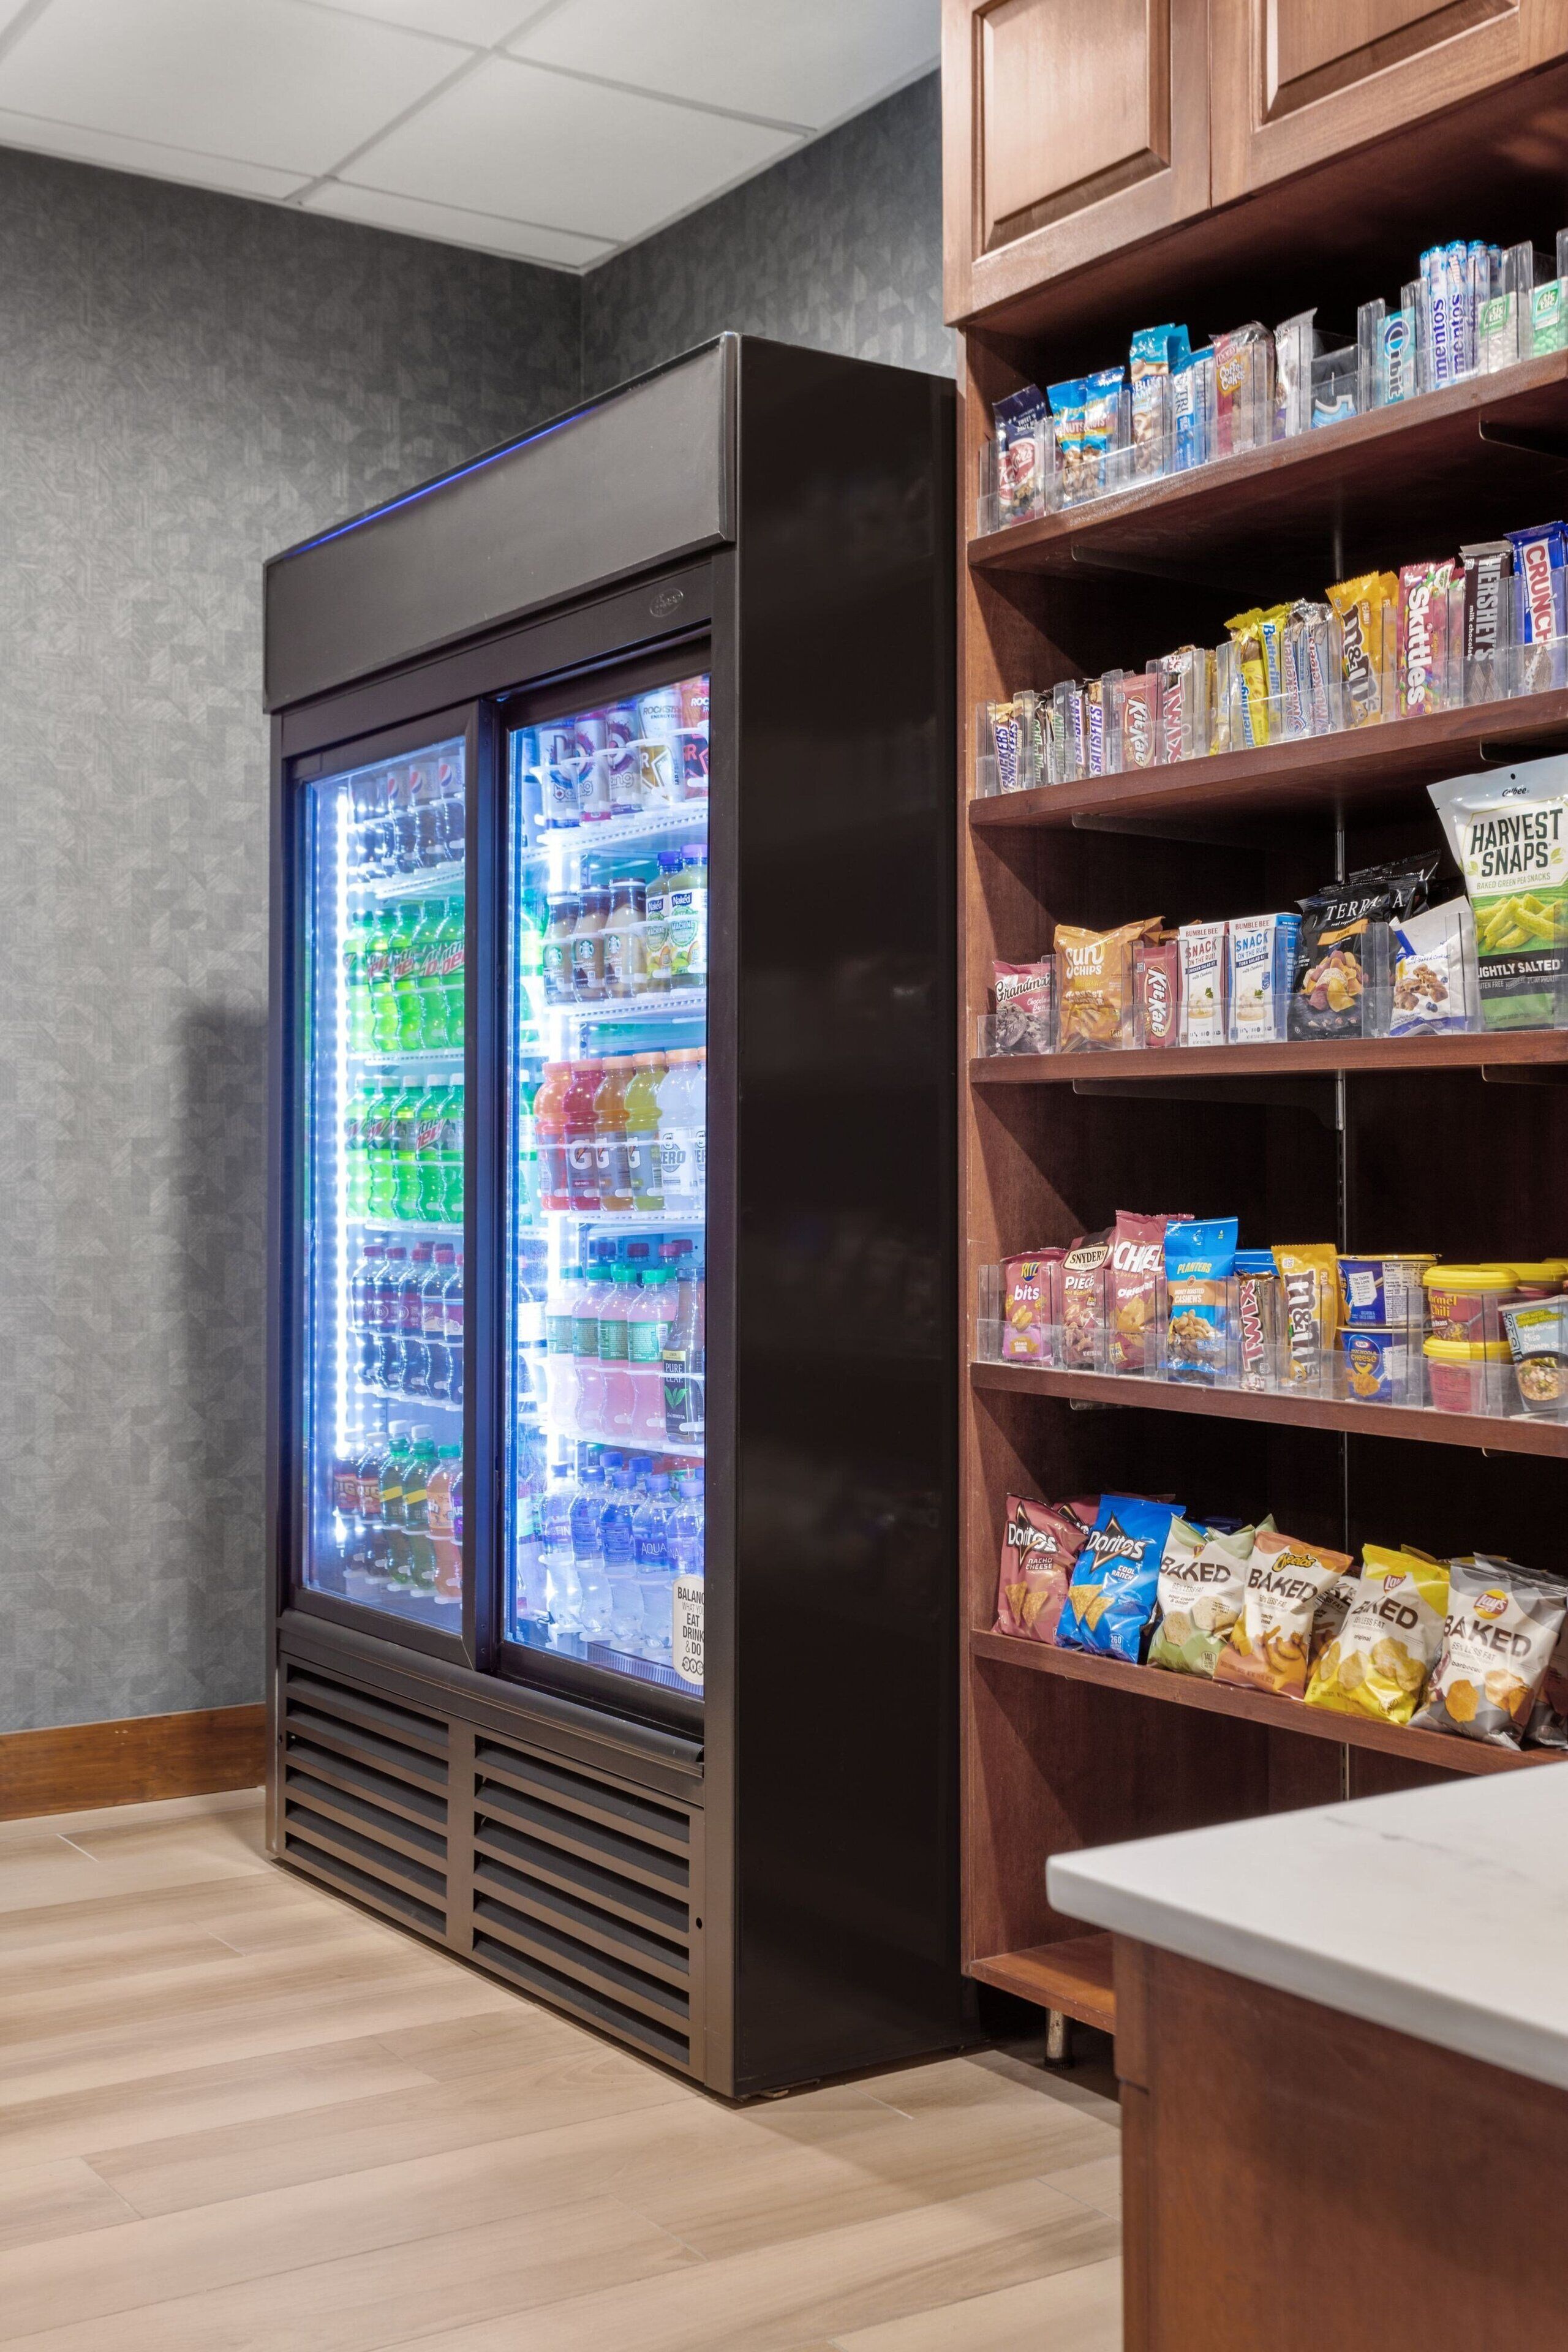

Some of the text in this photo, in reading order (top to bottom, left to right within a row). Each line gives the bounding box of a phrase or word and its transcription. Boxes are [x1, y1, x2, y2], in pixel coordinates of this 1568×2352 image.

[1433, 298, 1447, 380] mentos
[1452, 293, 1465, 374] mentos
[1385, 317, 1410, 399] Orbit
[1219, 359, 1243, 377] Coffee
[1526, 545, 1552, 647] CRUNCH
[1474, 558, 1501, 662] HERSHEY'S
[1408, 586, 1432, 705] Skittles
[1163, 675, 1185, 764] TWIX
[1090, 705, 1103, 773] SATISFIES
[996, 726, 1009, 789] SNICKERS
[1008, 722, 1019, 788] SNICKERS
[1470, 808, 1563, 856] HARVEST
[1482, 842, 1548, 877] SNAPS
[1477, 881, 1496, 890] BAKED
[1498, 879, 1516, 888] GREEN
[1527, 872, 1551, 883] SNACKS
[1327, 896, 1380, 921] TERRA
[1185, 929, 1207, 937] BUMBLE
[1235, 921, 1258, 930] BUMBLE
[1186, 939, 1217, 959] SNACK
[1235, 931, 1268, 953] SNACK
[1246, 949, 1256, 957] THE
[1073, 965, 1102, 976] CHIPS
[1517, 959, 1561, 973] SALTED
[569, 1138, 593, 1170] G
[1021, 1262, 1041, 1278] RITZ
[1177, 1262, 1212, 1275] PLANTERS
[1014, 1284, 1040, 1302] bits
[1174, 1294, 1202, 1304] CASHEWS
[1240, 1280, 1265, 1373] TWIX
[665, 1363, 683, 1373] PURE
[1008, 1523, 1058, 1553] Doritos
[1086, 1531, 1146, 1559] Doritos
[641, 1542, 667, 1558] AQUA
[1111, 1570, 1134, 1581] RANCH
[1118, 1565, 1135, 1575] COOL
[1159, 1556, 1232, 1583] BAKED
[1247, 1568, 1318, 1604] BAKED
[682, 1601, 695, 1611] WHAT
[1475, 1594, 1507, 1611] Lay's
[687, 1613, 700, 1627] EAT
[1373, 1620, 1386, 1629] FAT
[683, 1625, 704, 1643] DRINK
[1110, 1635, 1121, 1644] 260
[1443, 1615, 1532, 1657] BAKED
[685, 1640, 701, 1656] & DO
[1482, 1650, 1496, 1662] FAT
